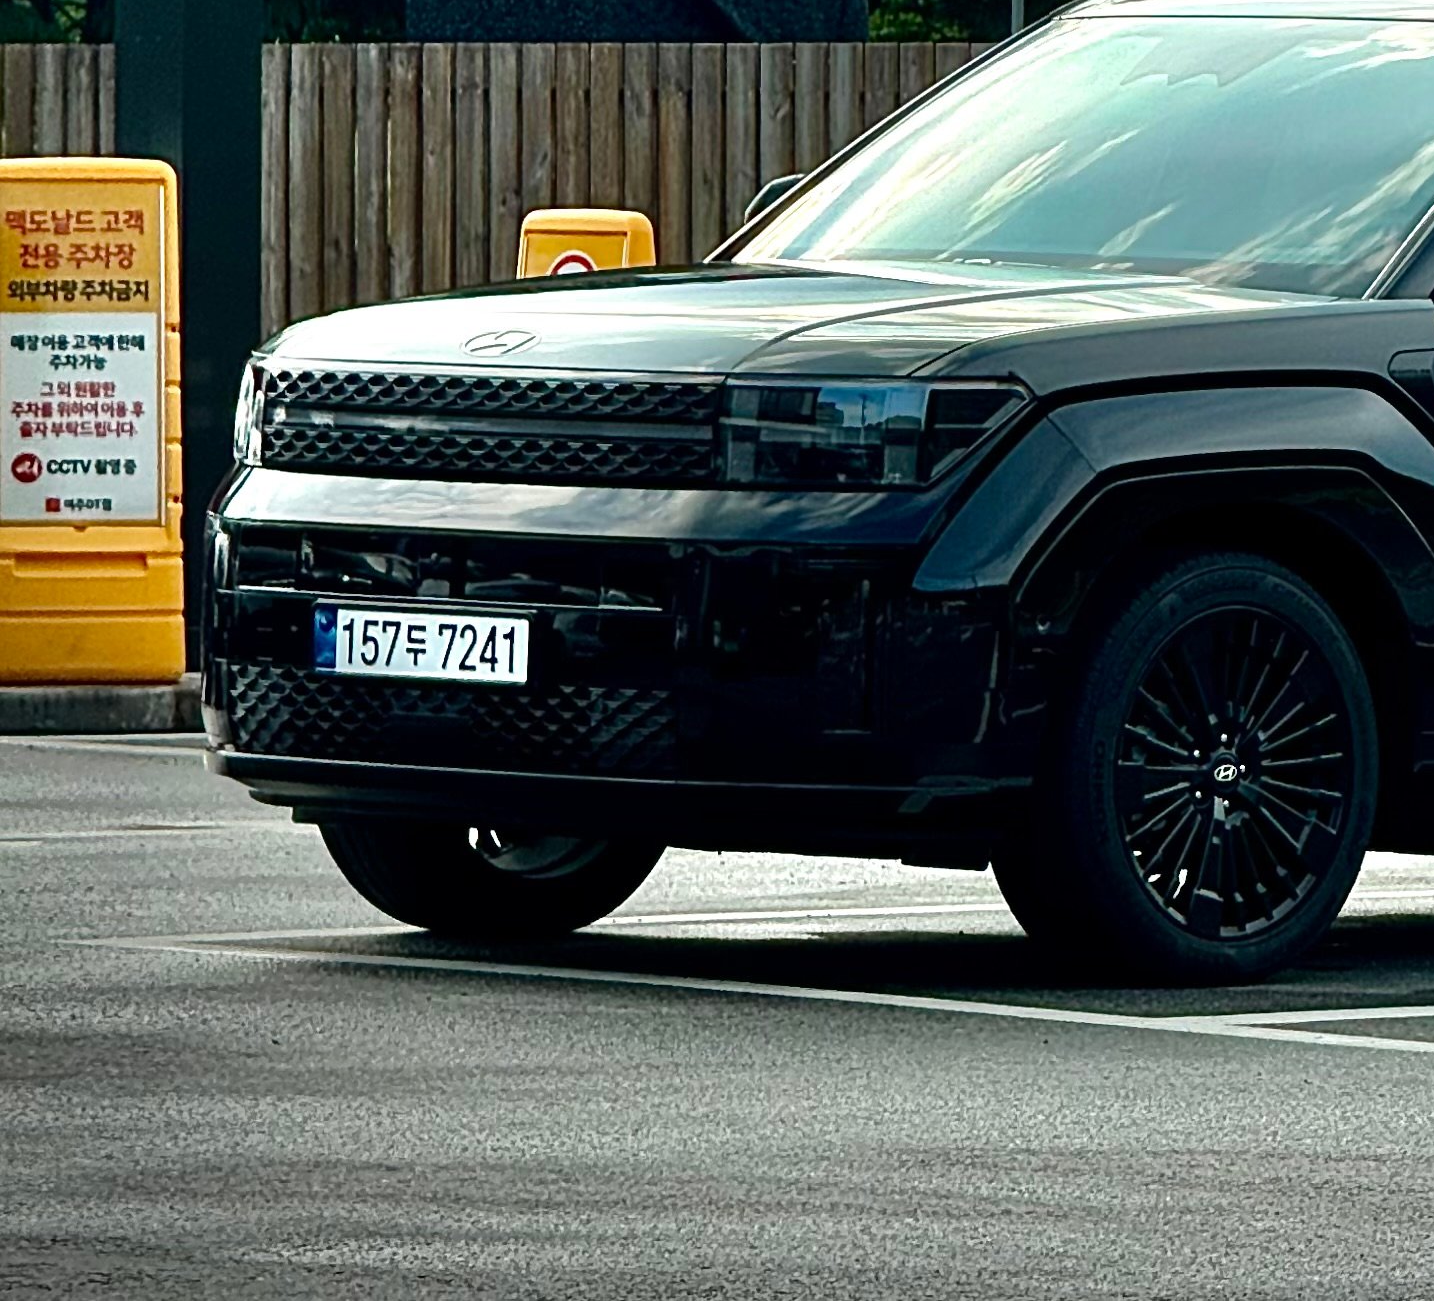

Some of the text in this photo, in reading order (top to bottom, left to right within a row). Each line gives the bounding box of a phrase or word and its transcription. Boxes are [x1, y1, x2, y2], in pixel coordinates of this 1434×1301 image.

[5, 209, 144, 235] 맥도날드 고객
[19, 243, 137, 270] 전용 주차장
[46, 459, 91, 474] CCTV
[342, 618, 515, 674] 157두 7241
